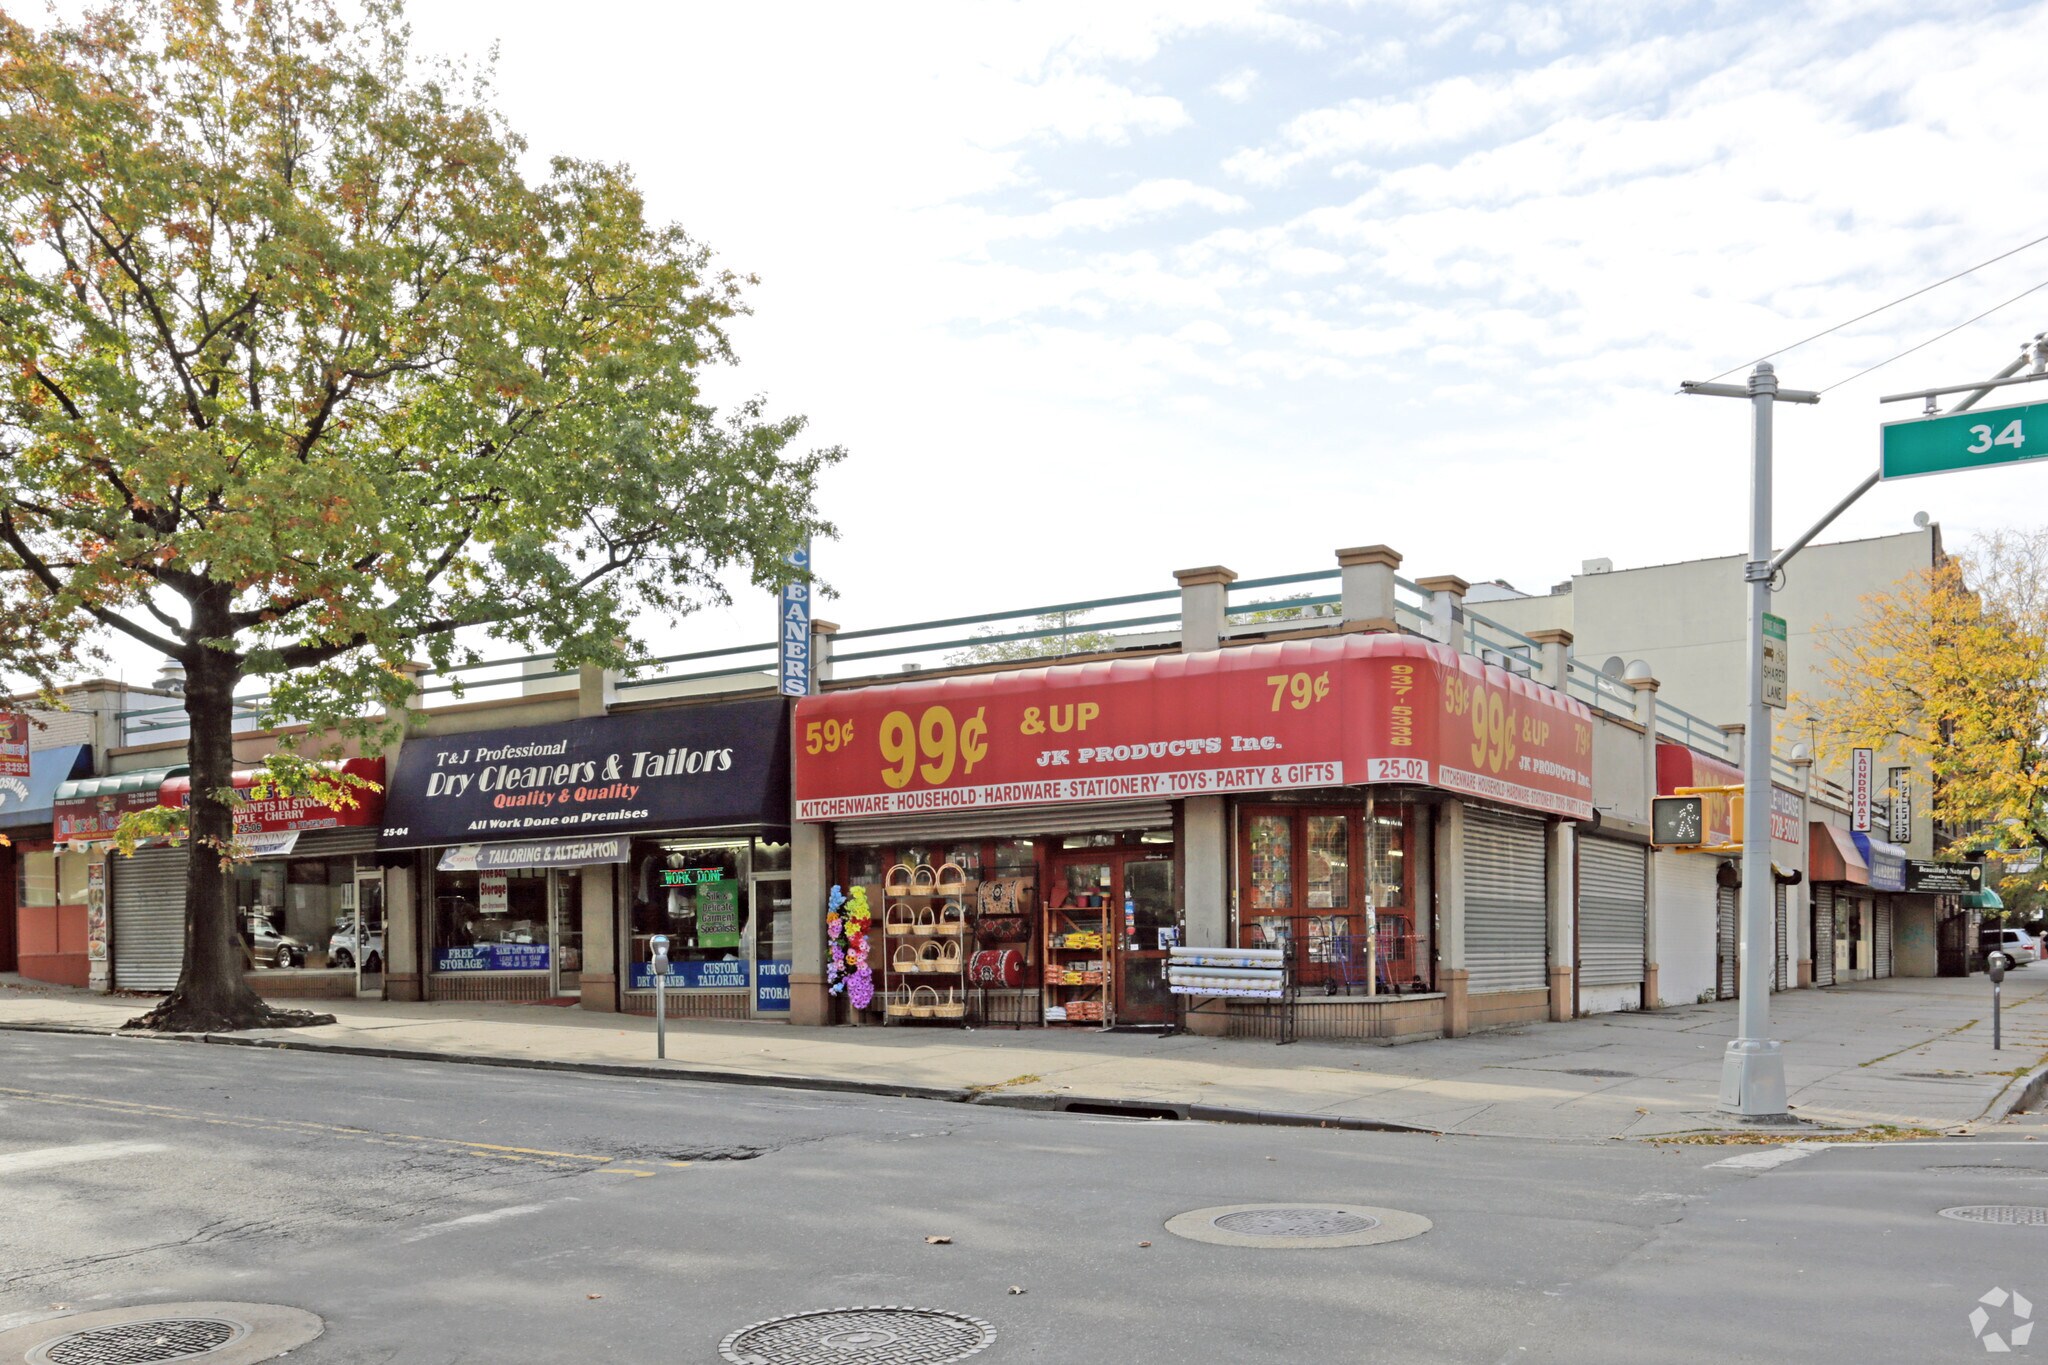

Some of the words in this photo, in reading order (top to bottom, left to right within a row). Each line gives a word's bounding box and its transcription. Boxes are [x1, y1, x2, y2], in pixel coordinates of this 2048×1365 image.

[1967, 419, 2025, 454] 34
[785, 544, 808, 695] CEANERS
[1763, 665, 1785, 684] SHARED
[1767, 684, 1782, 701] LANE
[475, 739, 568, 763] Professional
[1037, 750, 1070, 767] JK
[1078, 736, 1221, 764] PRODUCTS
[1231, 735, 1282, 752] Inc.
[426, 772, 475, 798] Dry
[478, 760, 596, 793] Cleaners
[601, 753, 623, 781] &
[631, 747, 733, 779] Tailors
[1378, 759, 1423, 780] 25-02
[1519, 755, 1531, 772] JK
[1533, 758, 1576, 783] PRODUCTS
[1441, 767, 1476, 789] KITCHENWARE
[801, 795, 890, 818] KITCHENWARE
[897, 790, 977, 811] HOUSEHOLD
[985, 783, 1061, 804] HARDWARE
[1070, 776, 1159, 798] STATIONERY
[1169, 771, 1207, 791] TOYS
[1216, 766, 1265, 788] PARTY
[1271, 766, 1283, 784] &
[1287, 763, 1335, 784] GIFTS
[1858, 751, 1867, 821] LAUNDROMAT
[493, 789, 556, 809] Quality
[558, 788, 571, 803] &
[574, 782, 640, 803] Quality
[233, 801, 276, 815] ABINETS
[278, 800, 290, 811] IN
[233, 814, 256, 824] APLE
[264, 809, 305, 822] CHERRY
[468, 819, 487, 831] All
[489, 817, 521, 829] Work
[522, 815, 559, 828] Done
[561, 814, 578, 825] on
[581, 808, 649, 823] Premises
[239, 823, 262, 833] 25-06
[383, 827, 408, 837] 25-04
[452, 854, 475, 864] Expert
[488, 847, 542, 864] TAILORING
[543, 846, 551, 862] &
[553, 841, 619, 861] ALTERATION
[665, 870, 692, 885] WORK
[1950, 867, 1971, 875] Natural
[480, 882, 507, 898] Storage
[706, 891, 721, 900] Silk
[702, 903, 734, 912] Delicate
[702, 913, 736, 922] Garment
[700, 924, 737, 934] Specialists
[448, 949, 474, 959] FREE
[440, 958, 483, 970] STORAGE
[703, 962, 739, 975] CUSTOM
[760, 964, 777, 975] FUR
[779, 964, 791, 975] CO
[637, 976, 651, 987] DRY
[698, 974, 744, 986] TAILORING
